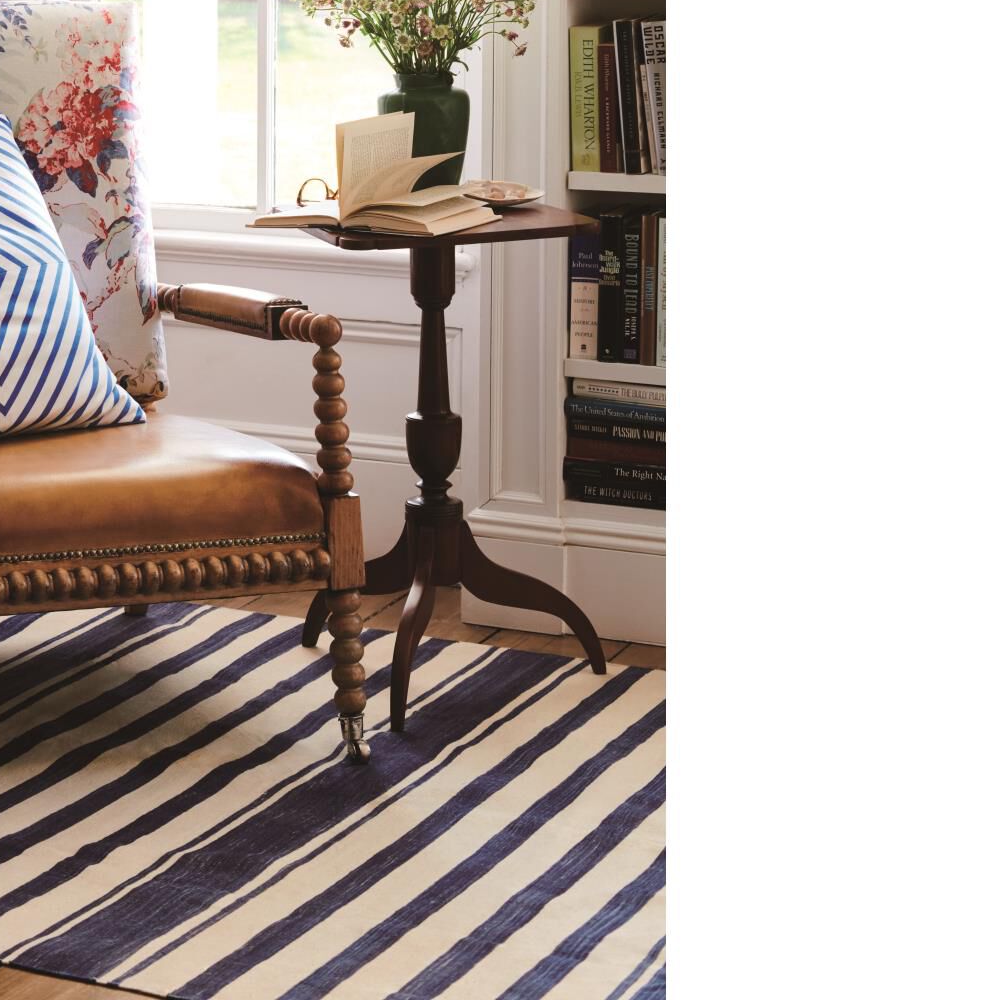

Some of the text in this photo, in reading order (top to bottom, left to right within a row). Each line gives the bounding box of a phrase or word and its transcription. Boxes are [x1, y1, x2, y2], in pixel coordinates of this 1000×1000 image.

[643, 26, 655, 65] WILDE
[654, 25, 666, 64] OSCAR
[582, 40, 595, 150] EDITH WHARTON
[654, 72, 663, 107] RICHARD
[600, 266, 620, 274] Jungle
[624, 234, 640, 314] BOUND TO LEAD
[621, 388, 630, 397] THE
[584, 406, 606, 415] United
[607, 408, 626, 417] States
[634, 411, 665, 422] Ambition
[612, 426, 655, 440] PASSION AND
[614, 468, 652, 480] The Right
[584, 485, 652, 501] THE WITCH DOCTORS
